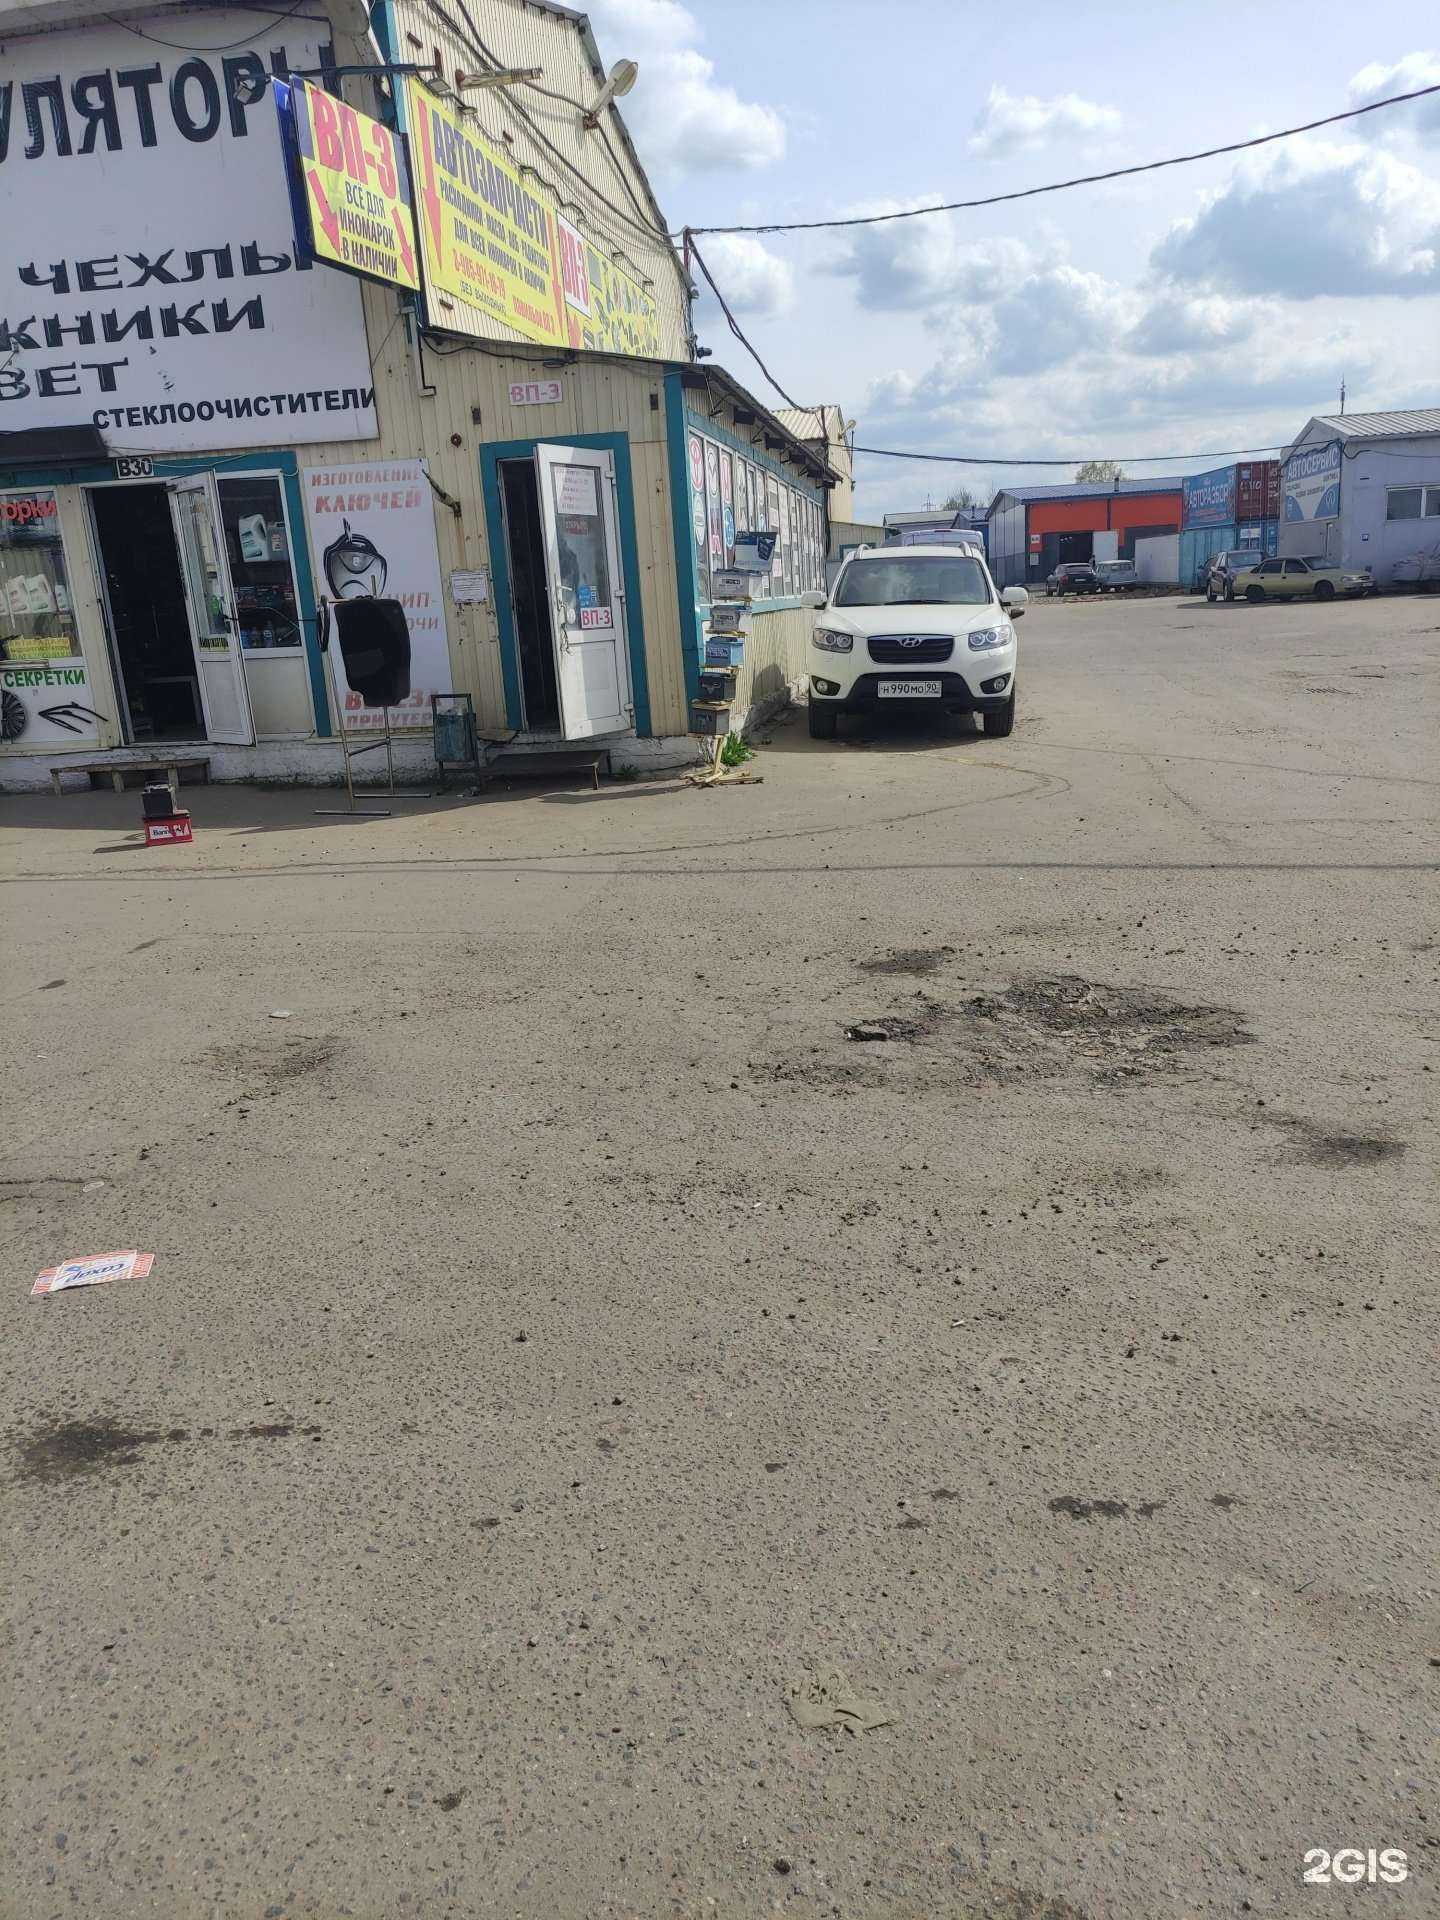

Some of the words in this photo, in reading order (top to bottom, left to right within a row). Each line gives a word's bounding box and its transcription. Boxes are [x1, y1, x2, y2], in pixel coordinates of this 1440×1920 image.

[311, 92, 397, 199] ВП-3
[432, 109, 549, 250] АВТОЗАПЧАСТИ
[366, 188, 386, 219] ДЛЯ
[339, 207, 396, 250] ИНОМАРОК
[18, 239, 313, 295] ЧЕХЛЫ
[342, 236, 351, 261] В
[351, 241, 398, 279] НАЛИЧИИ
[93, 387, 376, 429] СТЕКЛООЧИСТИТЕЛИ
[511, 383, 560, 401] ВП-3
[312, 468, 419, 487] ИЗГОТОВЛЕНИЕ
[1287, 447, 1338, 480] АВТОСЕРВИС
[0, 499, 57, 524] орки
[315, 486, 422, 513] КЛЮЧЕЙ
[582, 609, 610, 625] ВП-3
[4, 669, 86, 688] СЕКРЕТКИ
